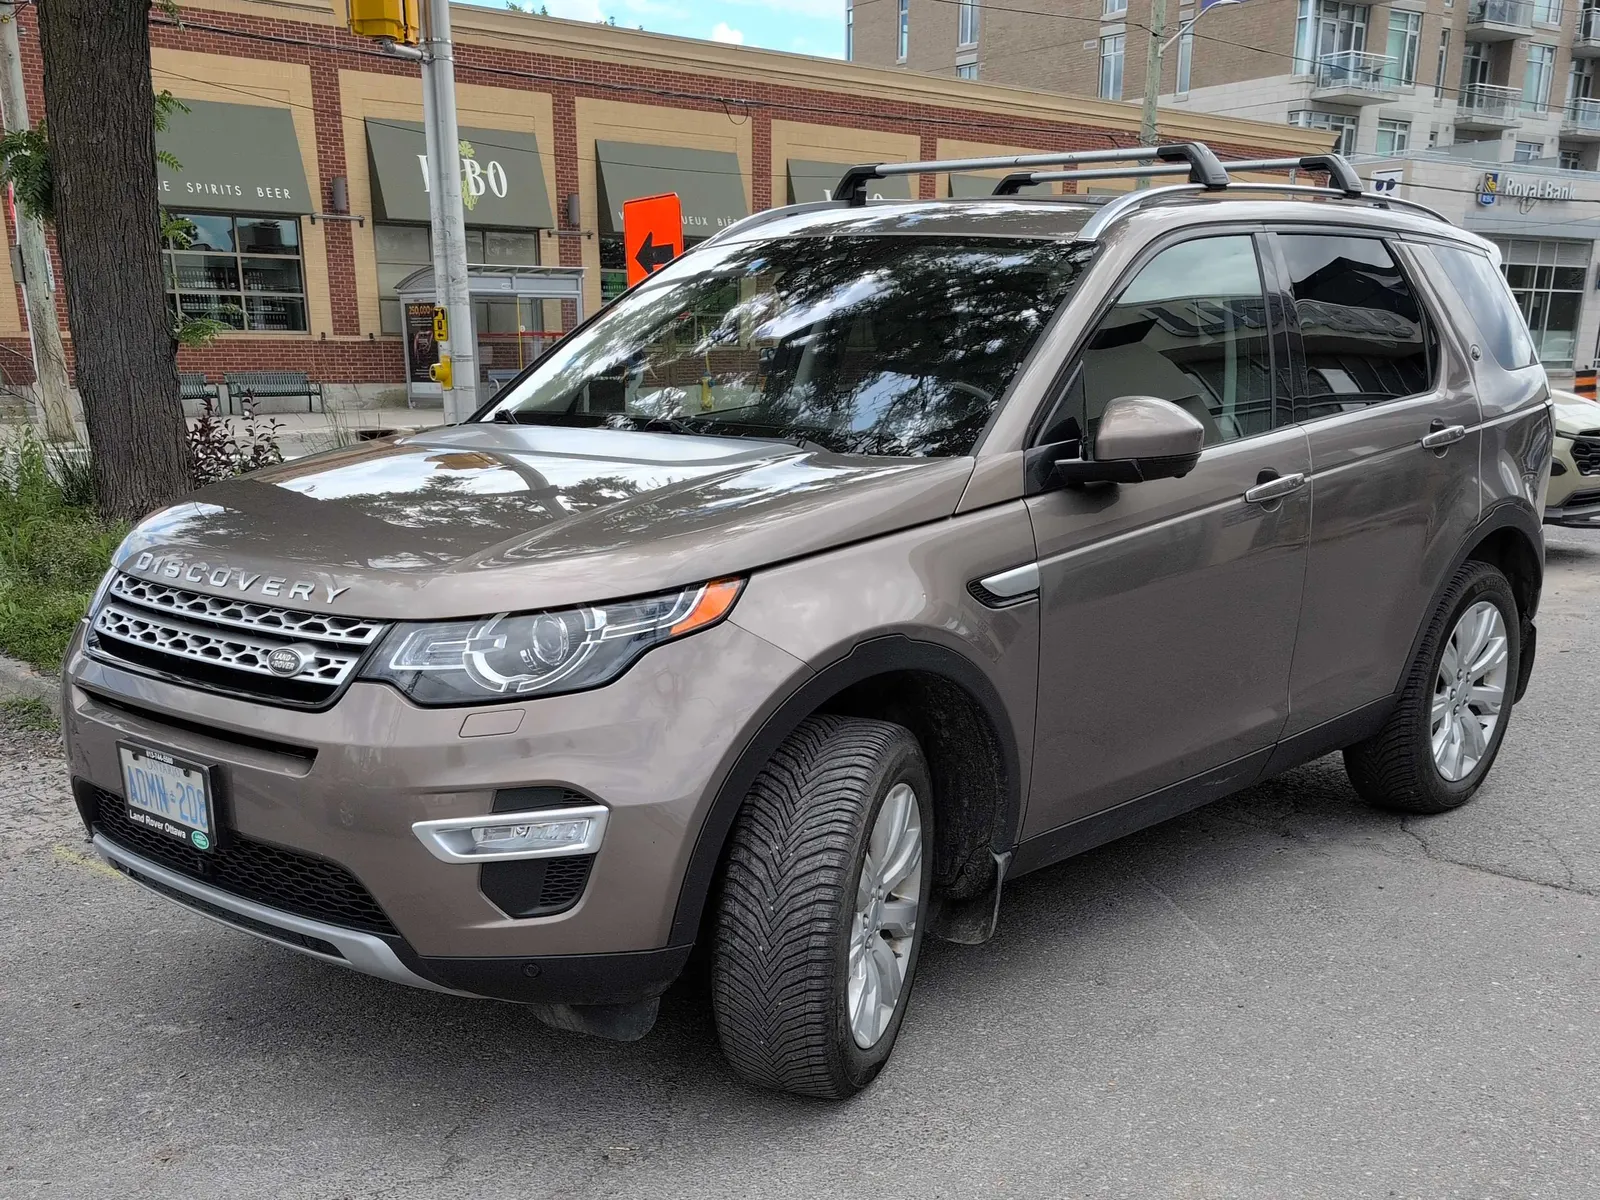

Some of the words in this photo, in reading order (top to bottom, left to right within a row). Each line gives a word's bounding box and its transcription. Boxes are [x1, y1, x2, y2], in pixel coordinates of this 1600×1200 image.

[186, 181, 242, 196] SPIRITS
[256, 186, 291, 200] BEER
[1545, 181, 1577, 200] Bank
[134, 552, 351, 604] DISCOVERY
[273, 652, 292, 661] LAND
[274, 660, 296, 670] ROVER
[129, 809, 144, 822] Land
[146, 816, 163, 830] Rover
[164, 823, 186, 838] Ottawa
